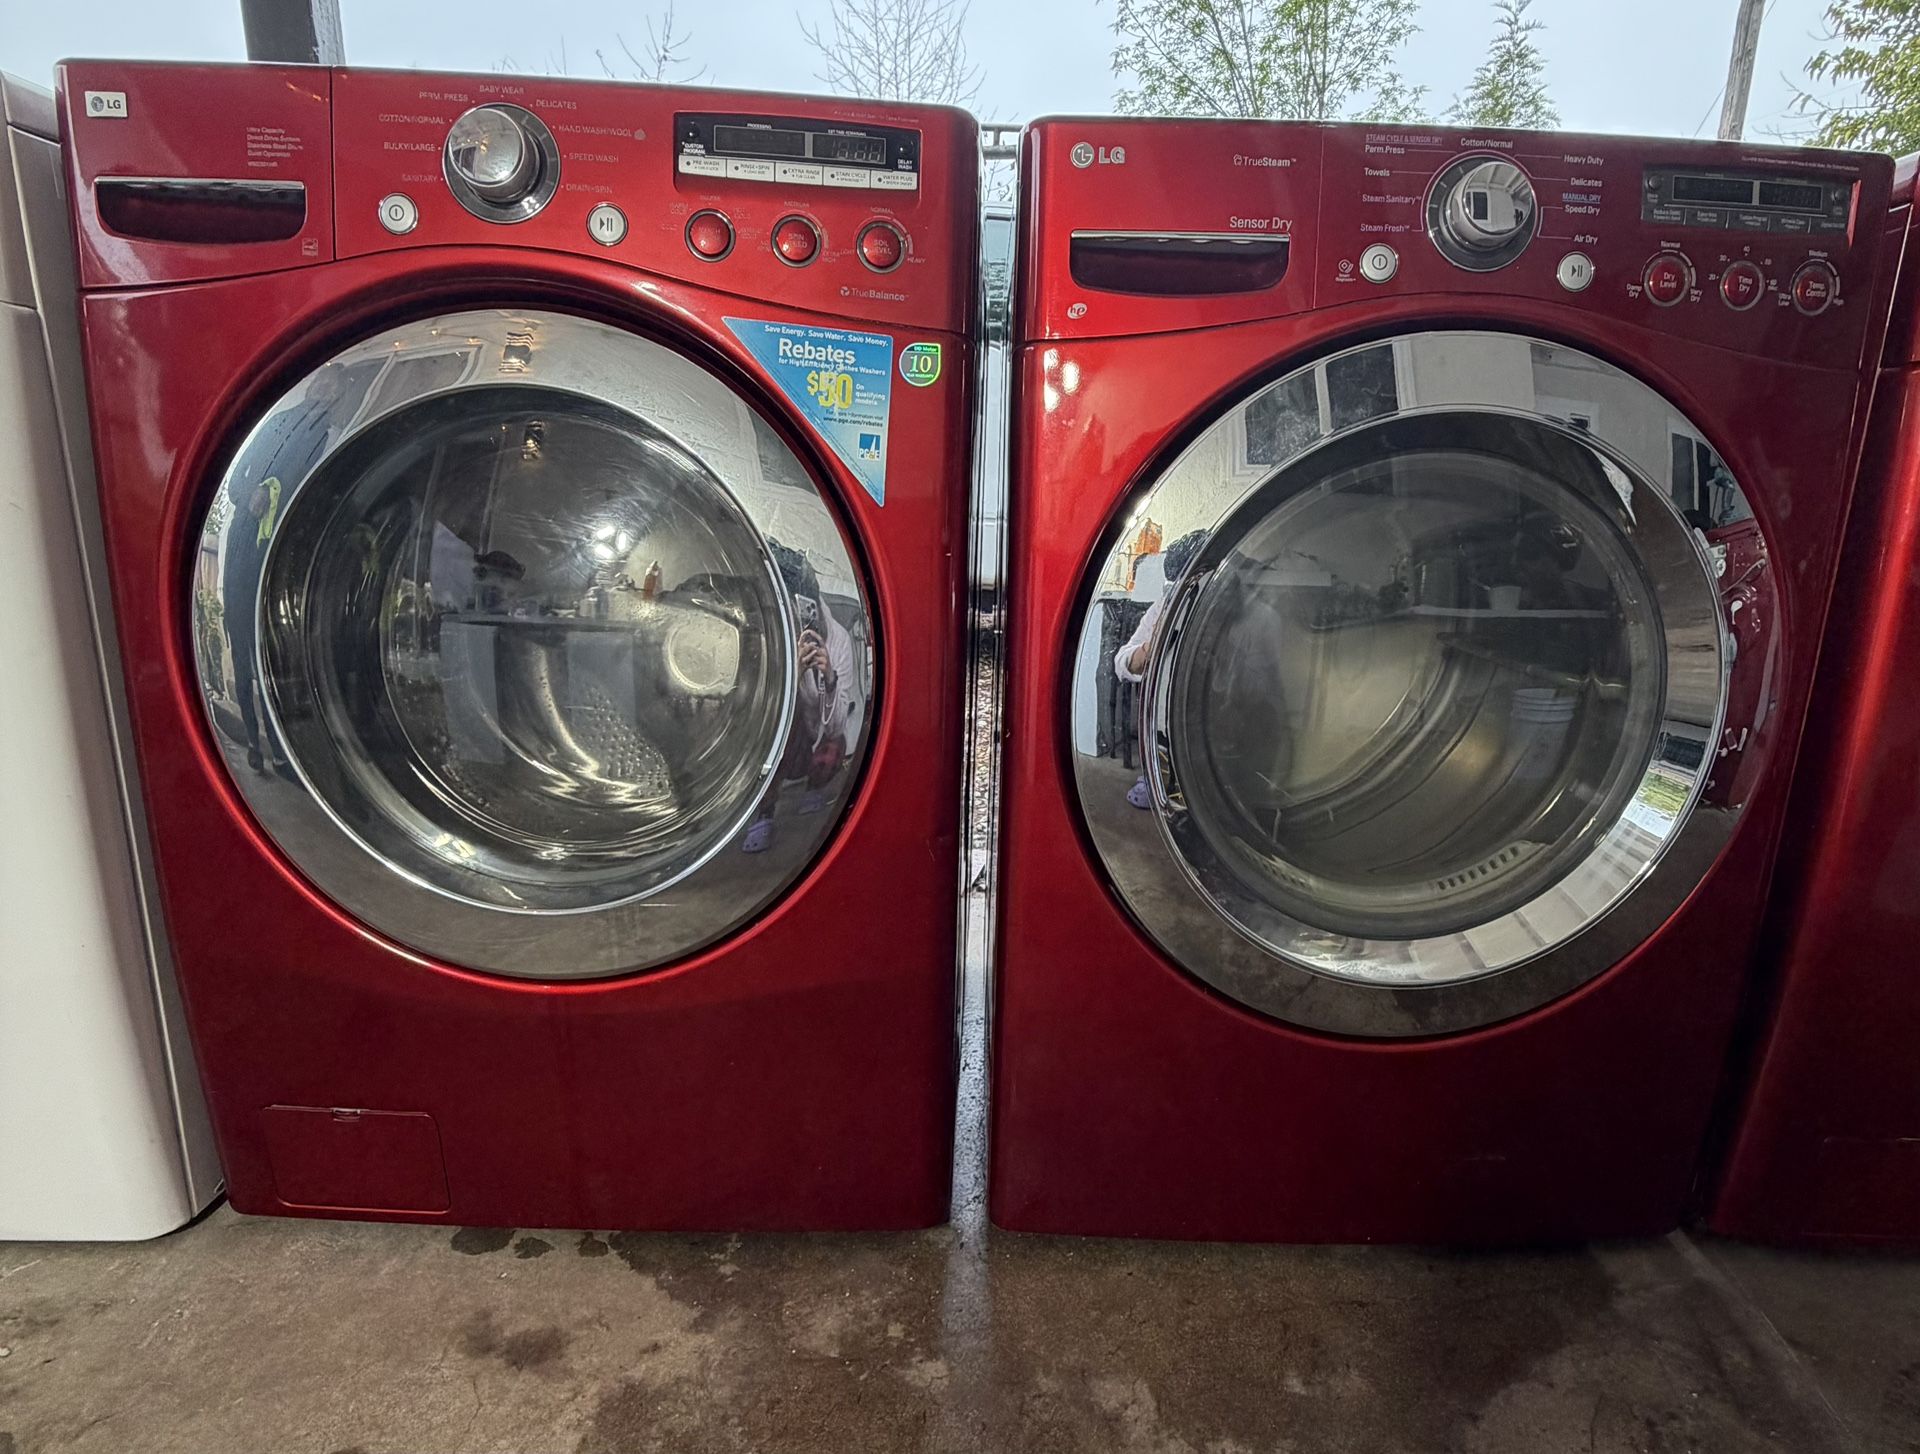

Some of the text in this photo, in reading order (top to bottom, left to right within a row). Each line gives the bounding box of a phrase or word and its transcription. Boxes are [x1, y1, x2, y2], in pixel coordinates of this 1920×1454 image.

[107, 99, 121, 109] LG
[536, 99, 577, 110] DELICATES
[1365, 144, 1405, 154] Perm Press
[1461, 138, 1513, 149] Cotton/Normal
[569, 152, 619, 163] SPEED WASH
[1099, 146, 1125, 164] LG
[1564, 154, 1604, 166] Heavy Duty
[1364, 167, 1390, 177] Towels
[1571, 177, 1602, 187] Delicates
[1362, 194, 1385, 203] Steam
[1563, 192, 1601, 202] MANUAL DRY
[1565, 204, 1600, 217] Speed Dry
[1230, 216, 1292, 231] Sensor Dry
[1360, 223, 1384, 232] Steam
[1574, 234, 1598, 246] Air Dry
[1664, 272, 1675, 281] Dry
[1626, 283, 1642, 291] Damp
[1660, 281, 1677, 289] Level
[1739, 283, 1750, 294] Dry
[1629, 291, 1639, 299] Dry
[1690, 295, 1701, 303] Dry
[765, 325, 889, 347] Save Energy. Save Water. Save Money.
[779, 338, 856, 365] Rebates
[779, 357, 788, 365] for
[859, 367, 886, 376] Washers
[910, 355, 931, 373] 10
[806, 370, 853, 409] $50
[855, 391, 886, 401] qualifying
